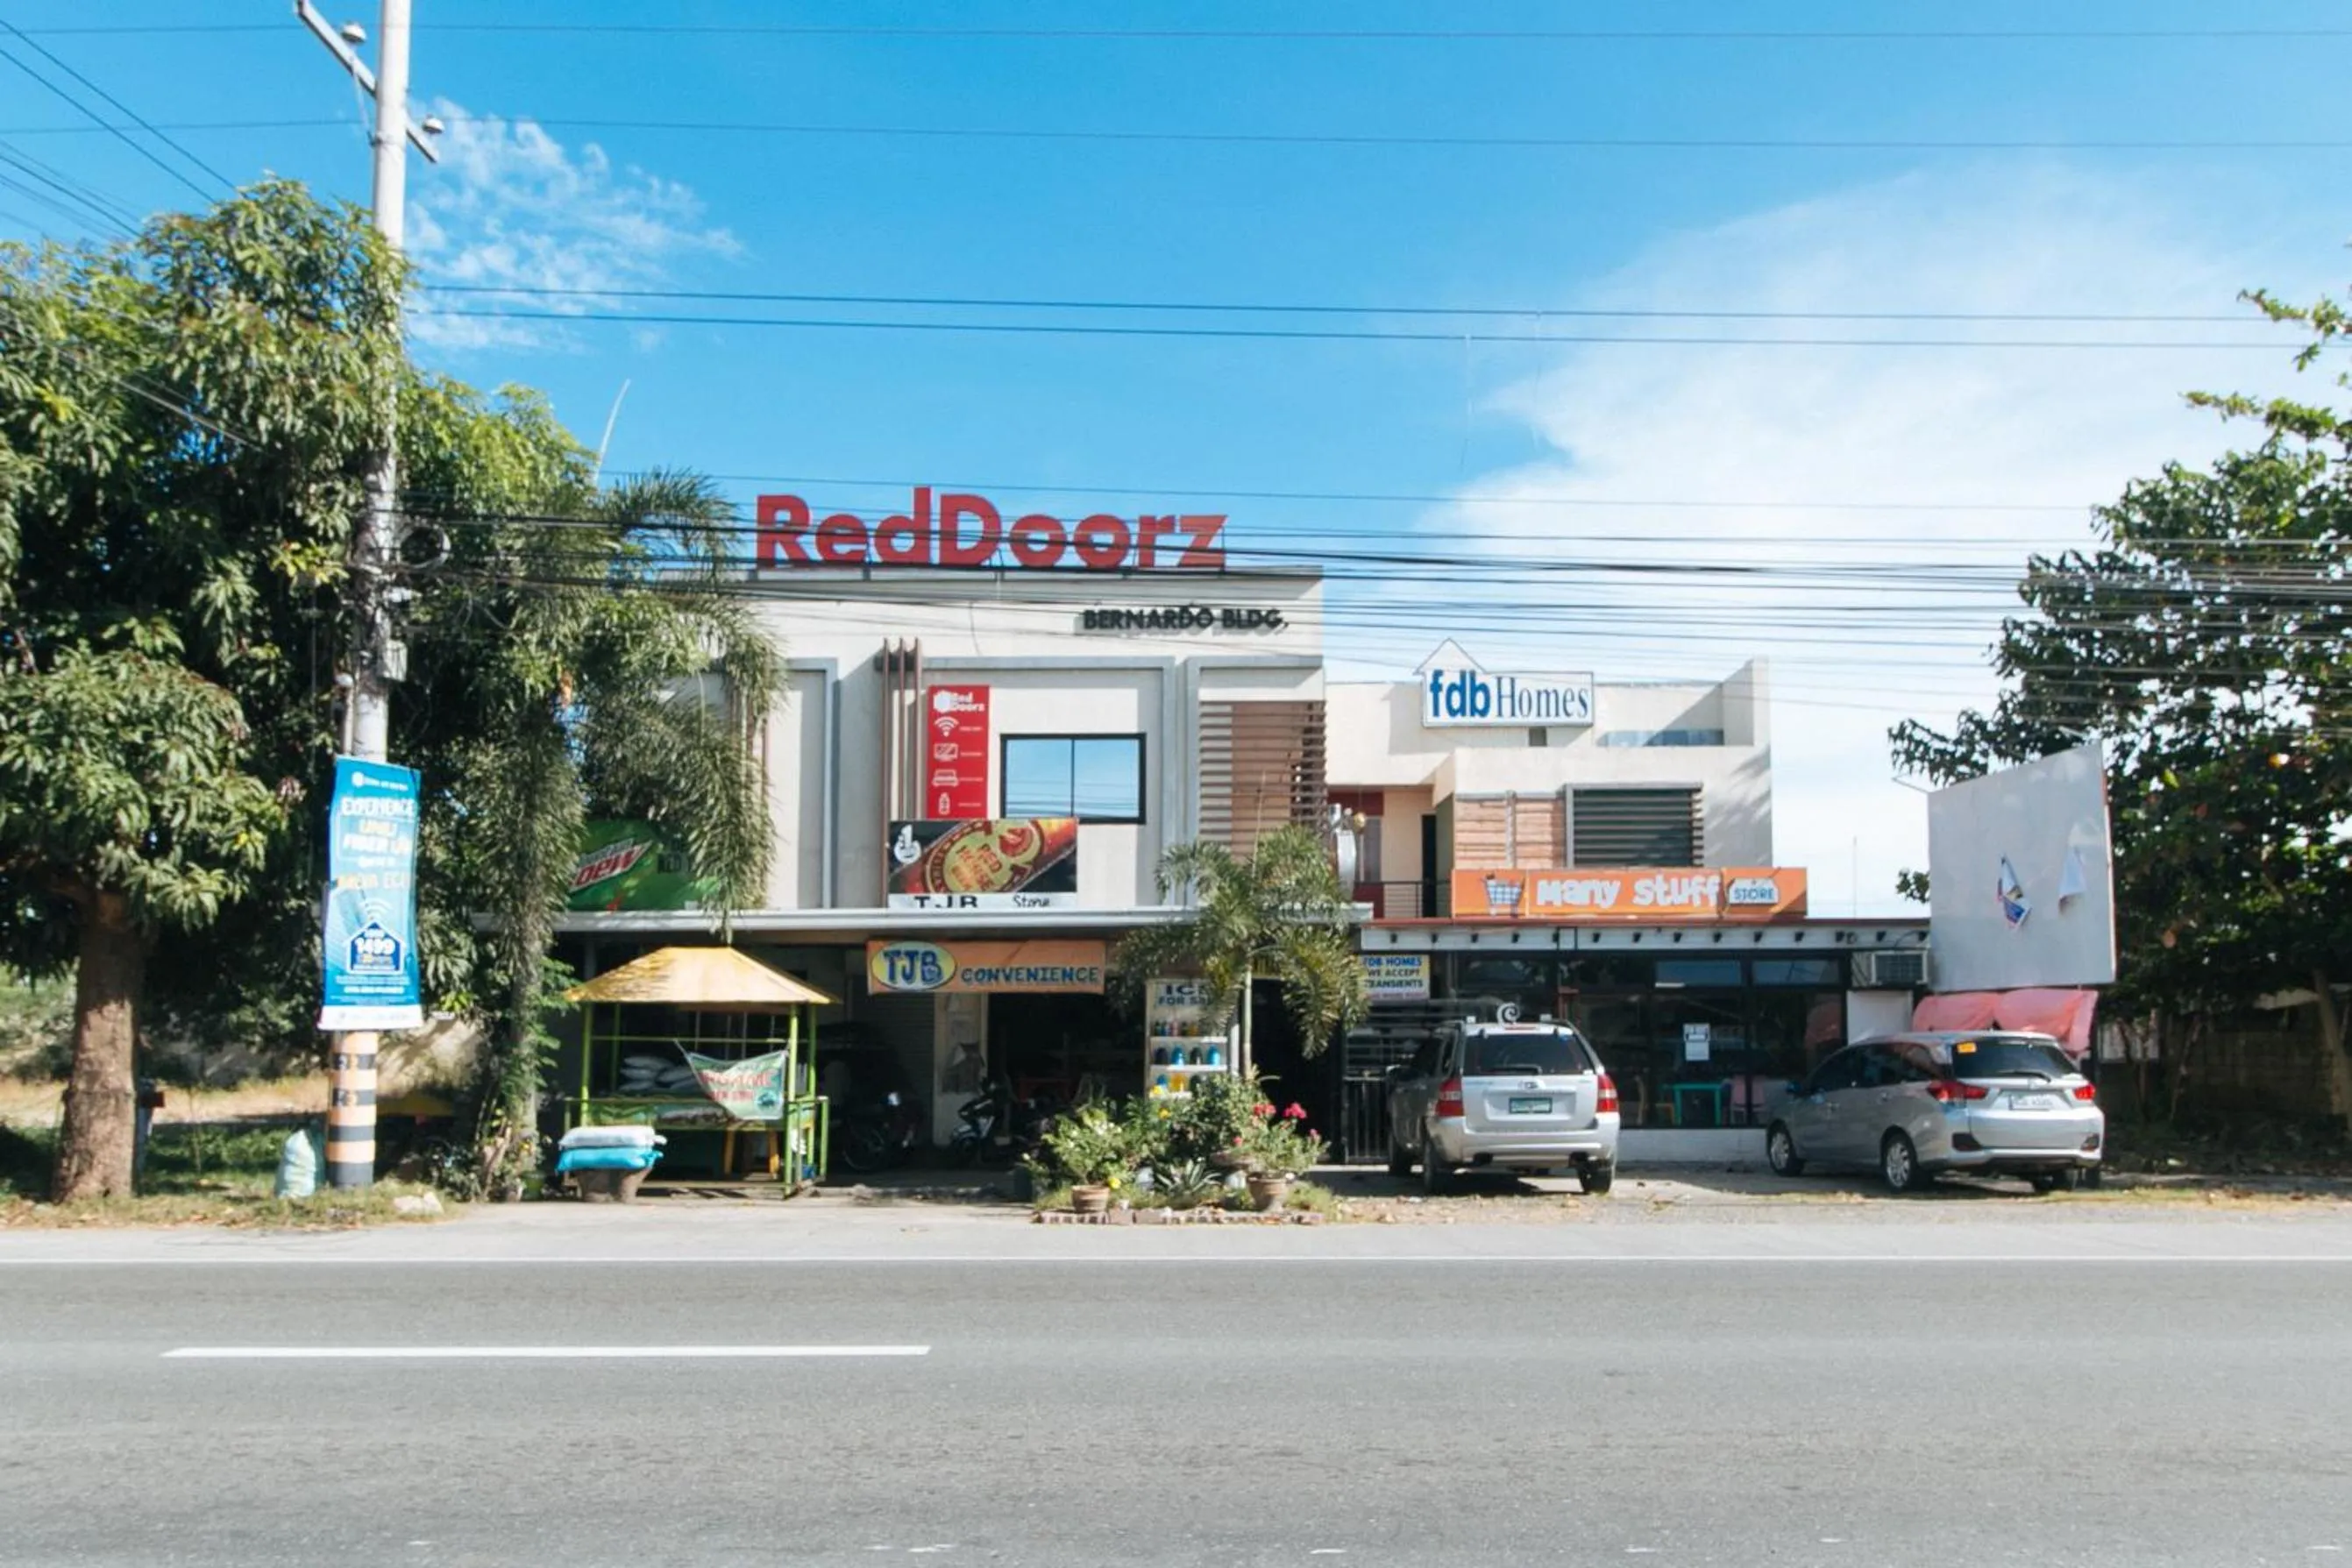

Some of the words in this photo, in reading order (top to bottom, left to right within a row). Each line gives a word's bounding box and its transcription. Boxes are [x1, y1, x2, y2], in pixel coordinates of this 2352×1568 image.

[756, 486, 1228, 569] RedDoorz
[1083, 607, 1214, 630] BERNARDO
[1429, 669, 1491, 719] fdb
[1495, 676, 1589, 719] Homes
[1732, 886, 1776, 902] STORE
[882, 949, 944, 983] TJB
[960, 966, 1099, 983] CONVENIENCE
[1385, 968, 1420, 977] ACCEPT
[1386, 956, 1422, 966] HOMES
